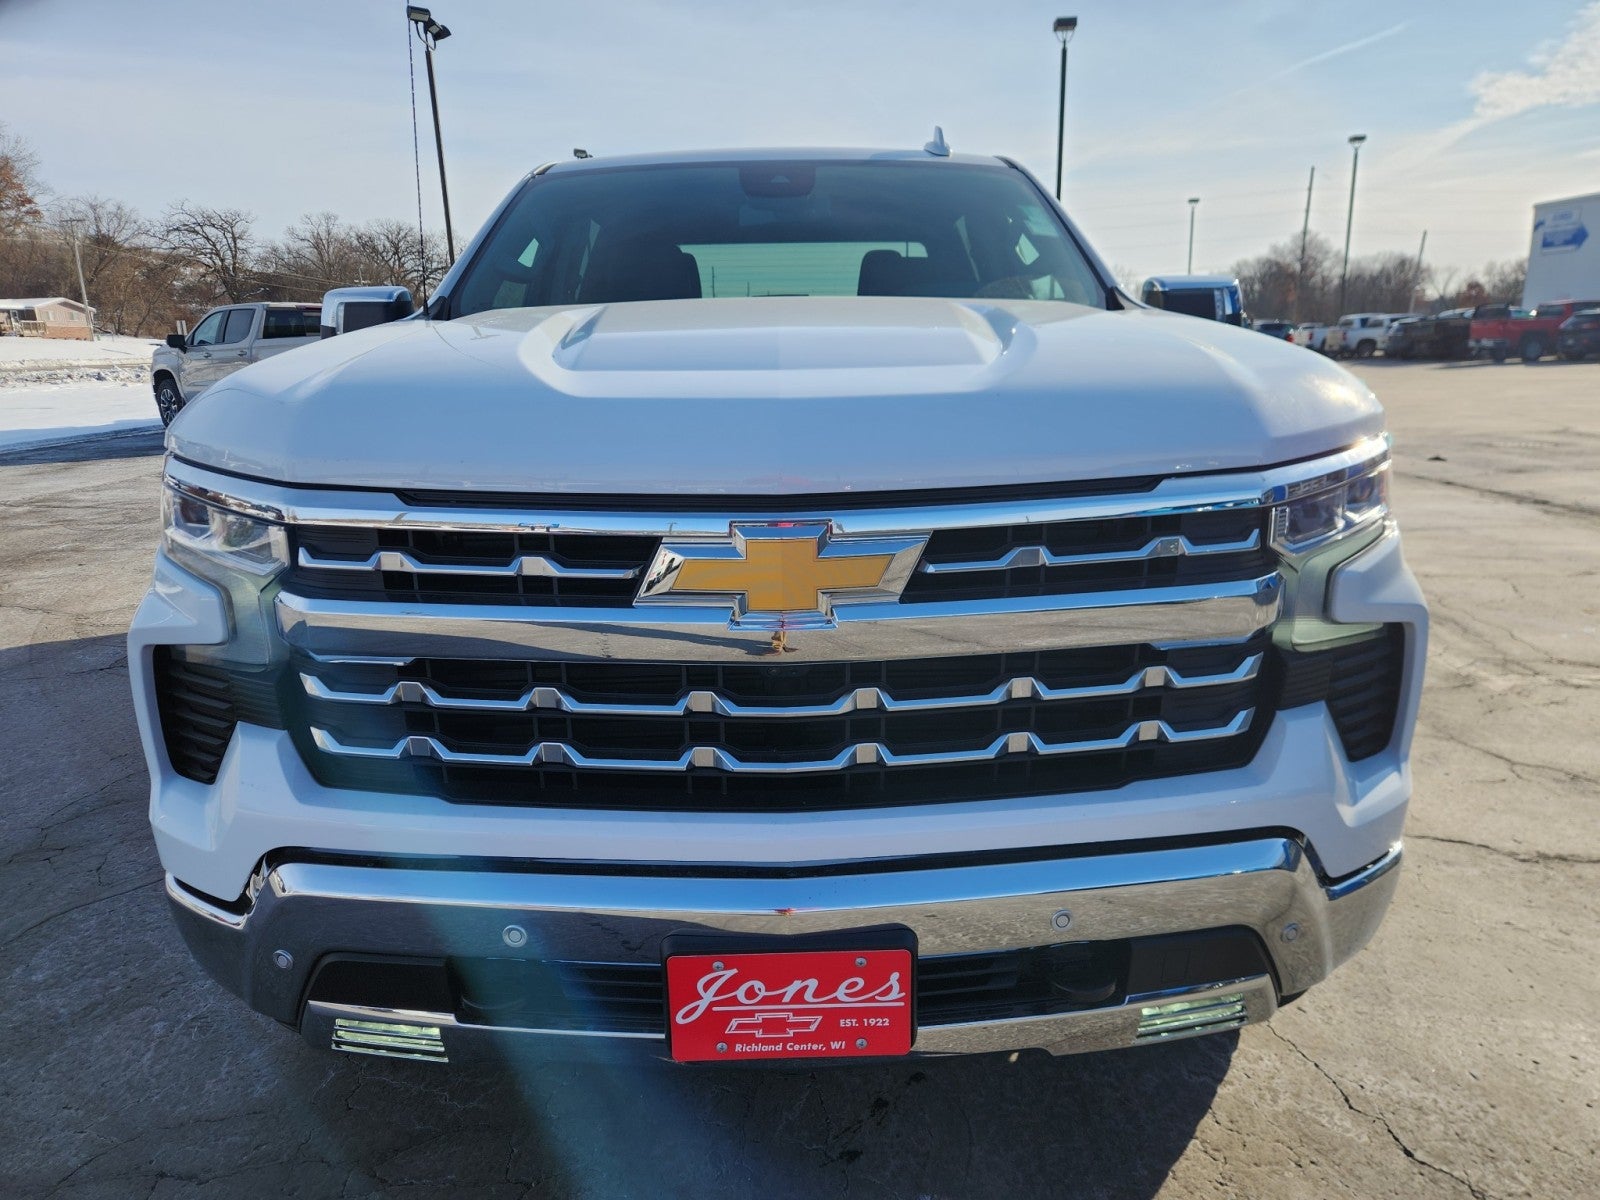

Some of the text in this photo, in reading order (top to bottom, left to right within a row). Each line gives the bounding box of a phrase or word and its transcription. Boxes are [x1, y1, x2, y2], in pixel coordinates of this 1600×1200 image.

[675, 968, 906, 1025] Jones
[839, 1017, 890, 1028] EST. 1922
[735, 1040, 846, 1052] Richland Center, WI
